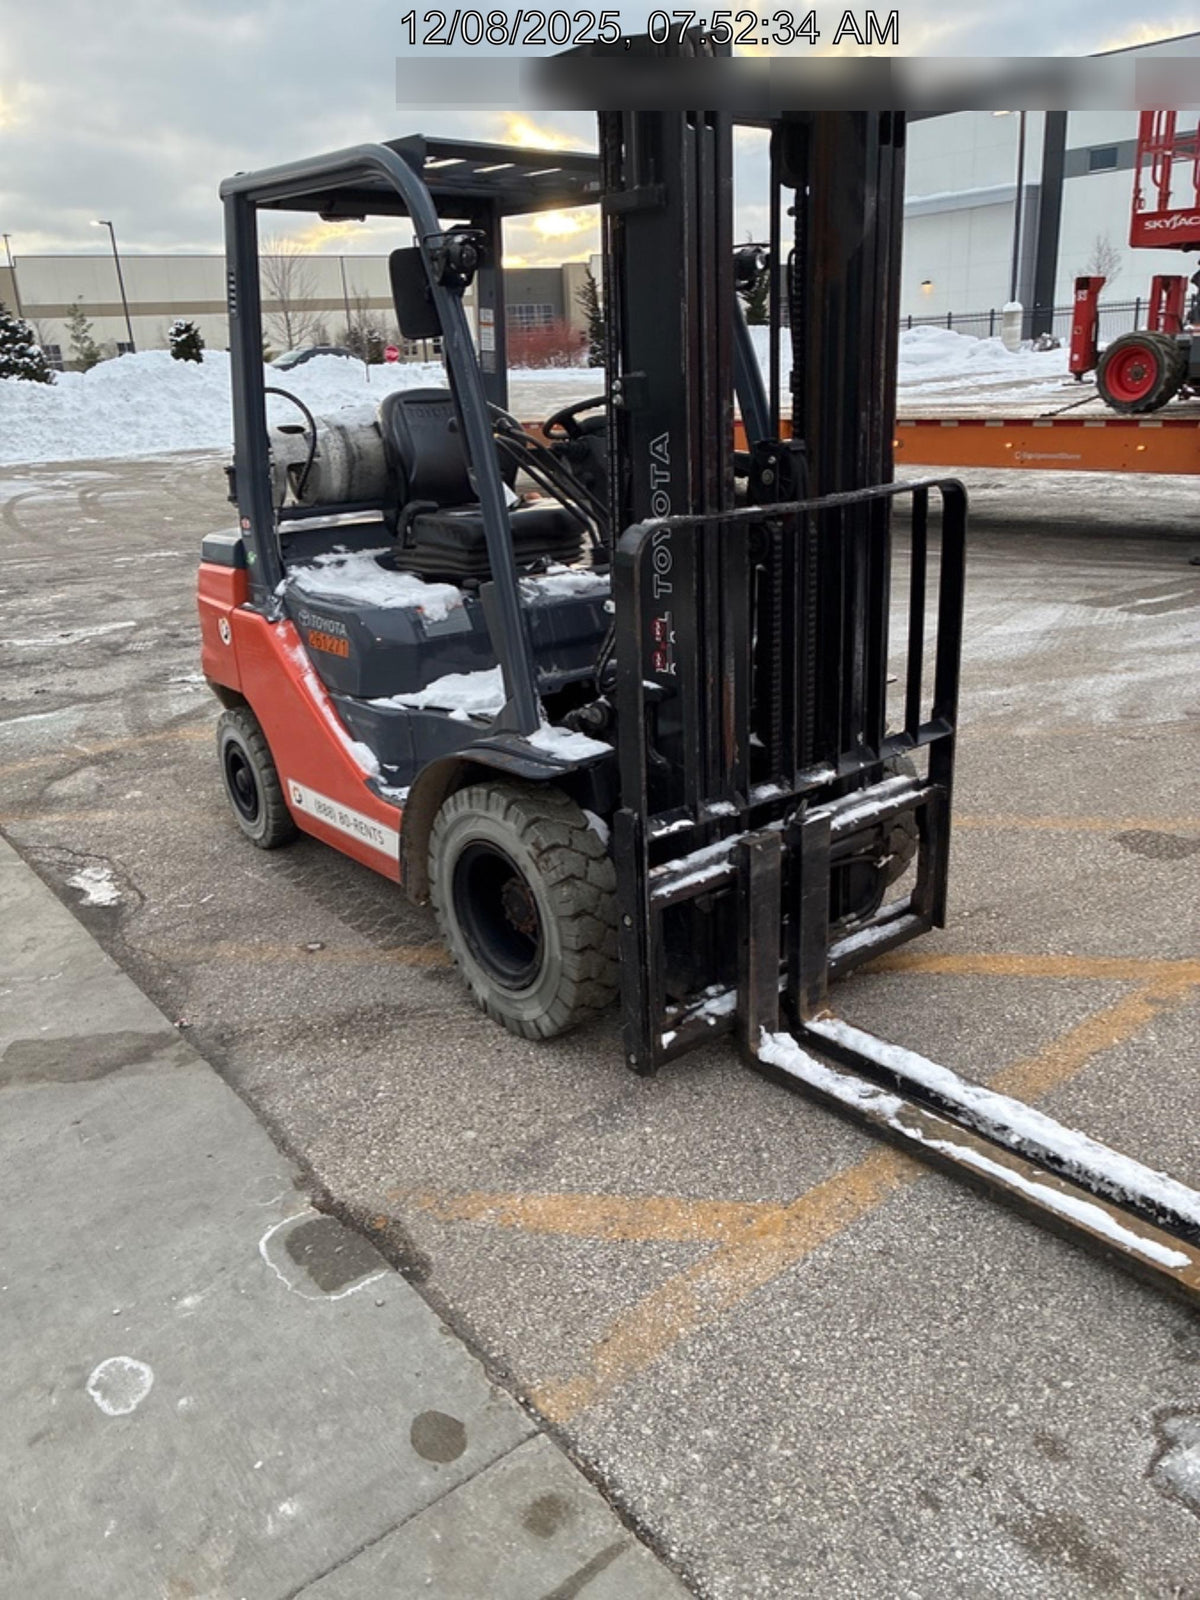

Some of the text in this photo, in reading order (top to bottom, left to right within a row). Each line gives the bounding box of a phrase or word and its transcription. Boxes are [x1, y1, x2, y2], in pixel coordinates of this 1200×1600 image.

[1144, 214, 1200, 230] SKYJAC
[311, 614, 348, 637] TOYOTA
[337, 811, 385, 846] 80-RENTS
